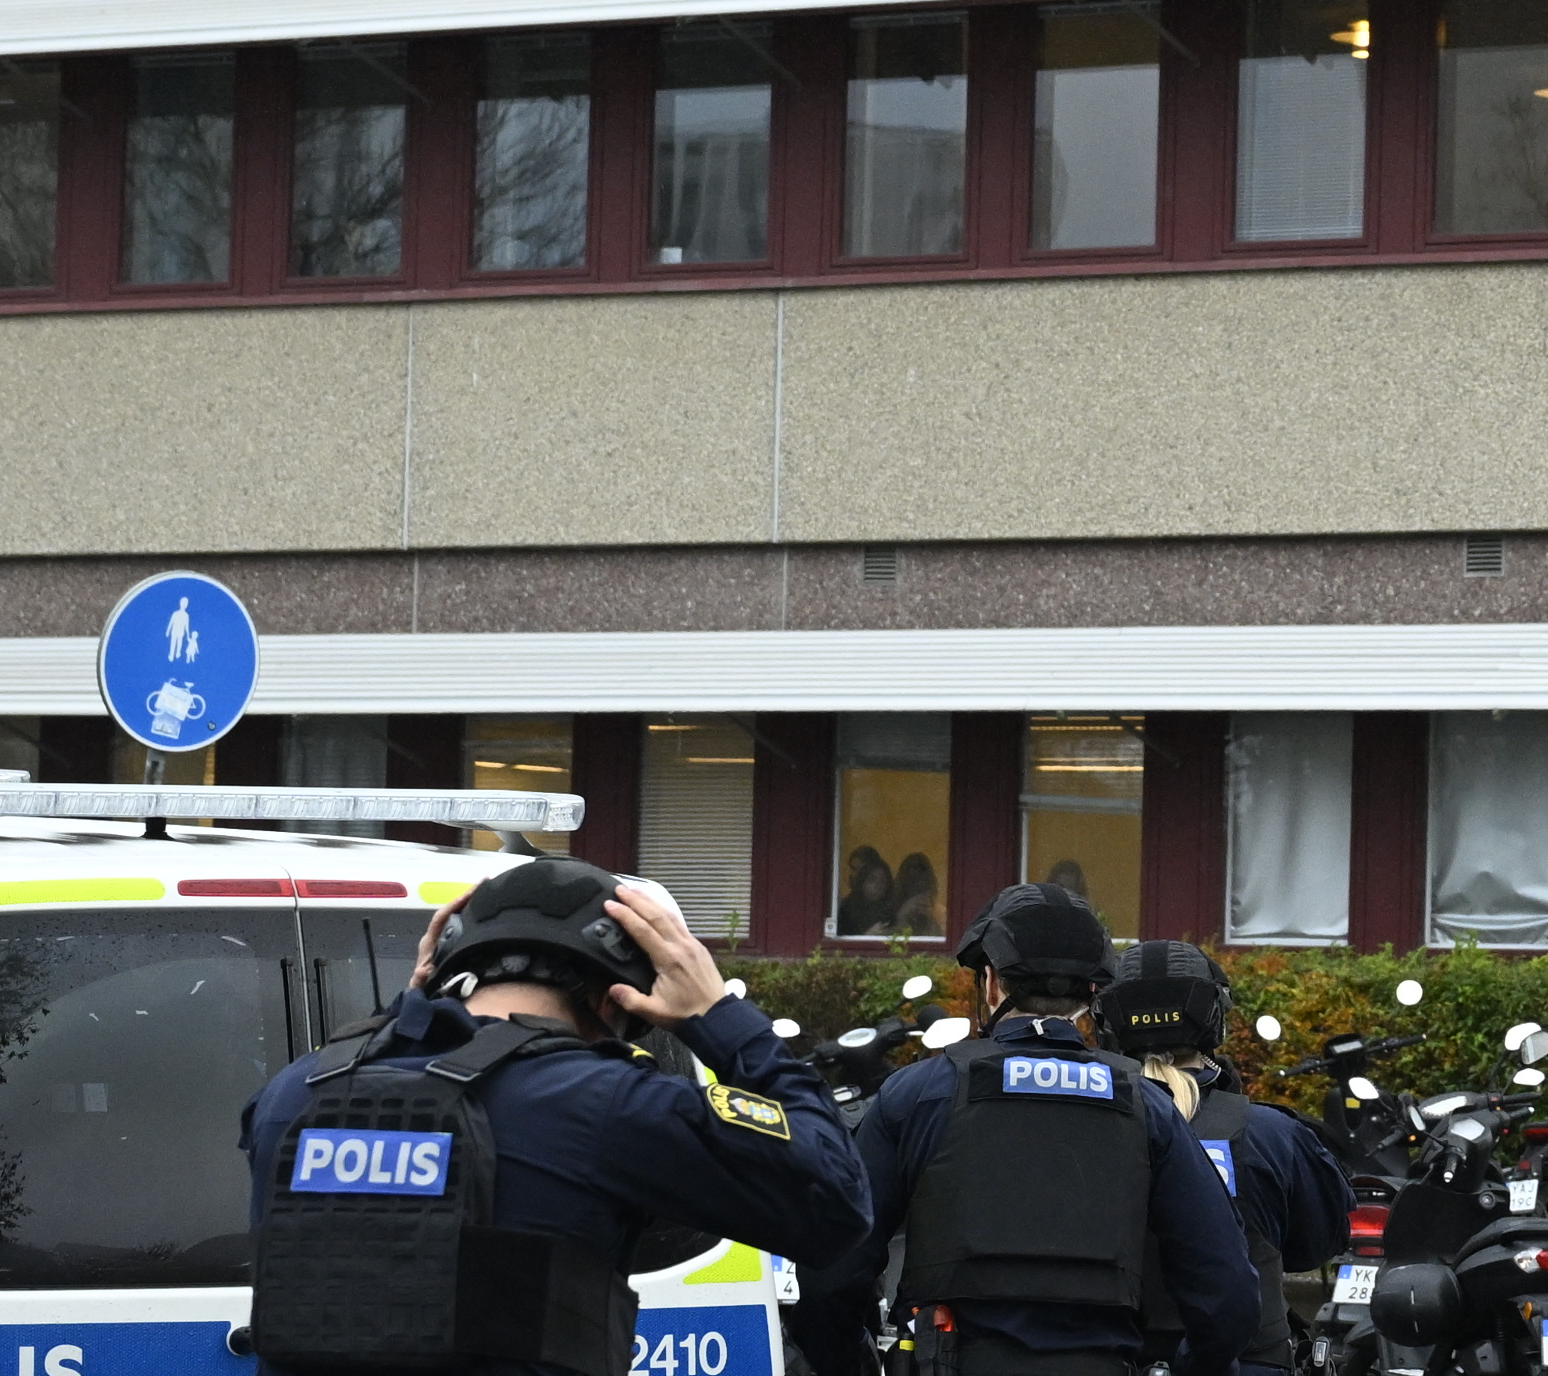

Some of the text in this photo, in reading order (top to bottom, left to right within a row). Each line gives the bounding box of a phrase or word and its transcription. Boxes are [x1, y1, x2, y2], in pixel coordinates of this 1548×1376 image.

[1131, 1011, 1181, 1026] POLIS
[1009, 1061, 1109, 1092] POLIS
[300, 1138, 441, 1186] POLIS
[1355, 1269, 1374, 1282] YK
[1348, 1286, 1369, 1300] 28
